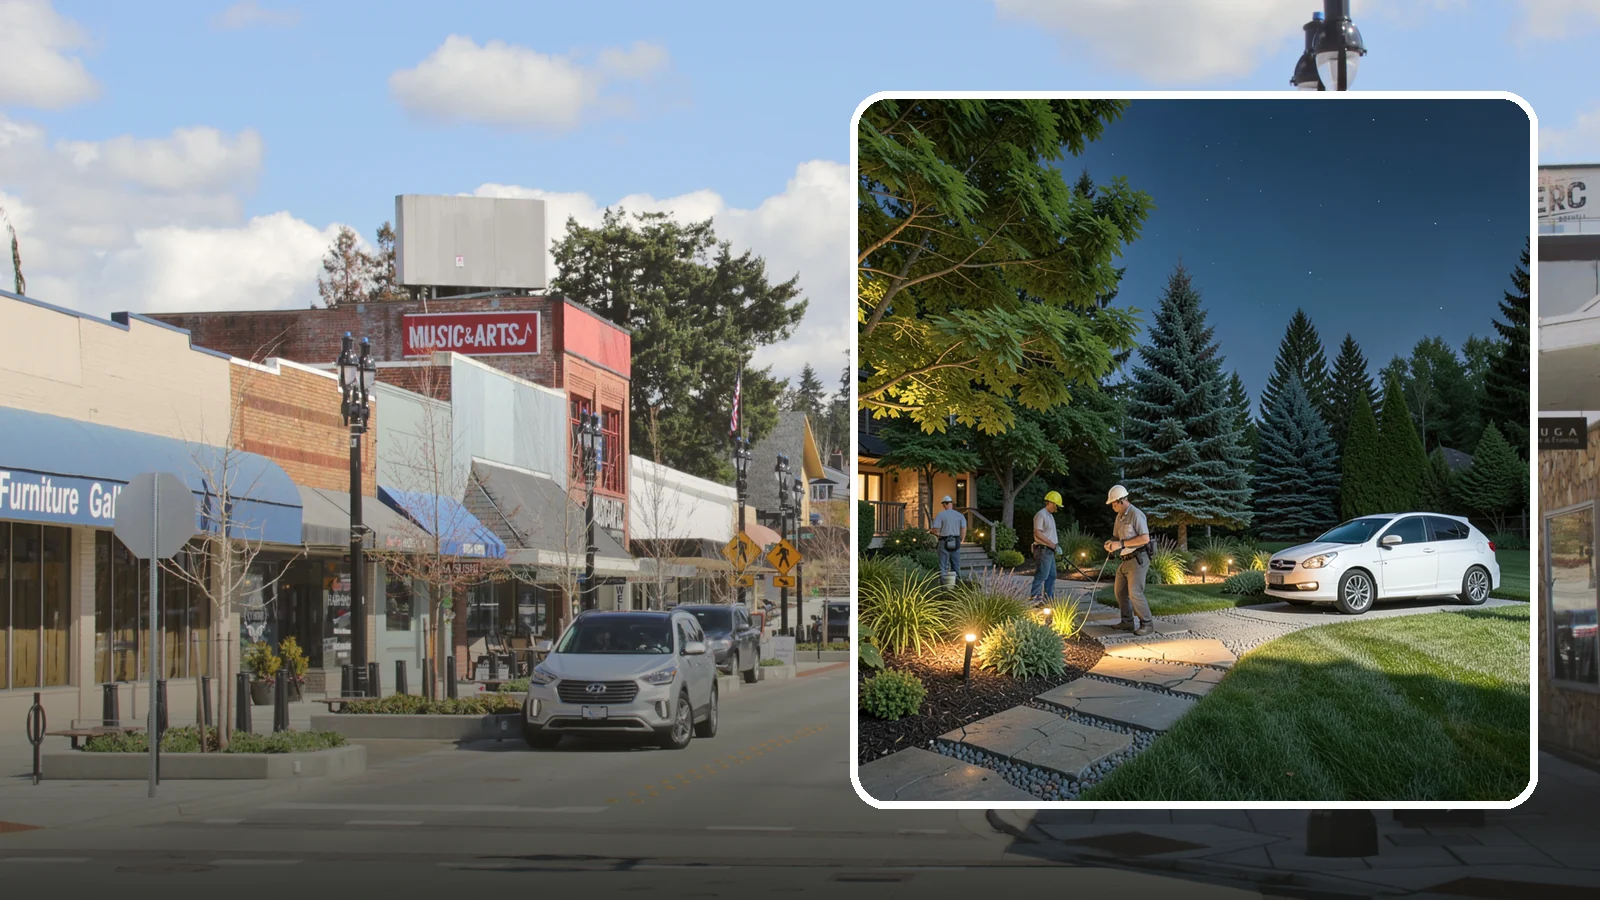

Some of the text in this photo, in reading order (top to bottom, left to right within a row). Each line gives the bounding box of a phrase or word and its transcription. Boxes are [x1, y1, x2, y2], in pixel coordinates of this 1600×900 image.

[1540, 427, 1577, 437] UGA
[0, 471, 122, 519] Furniture Gal
